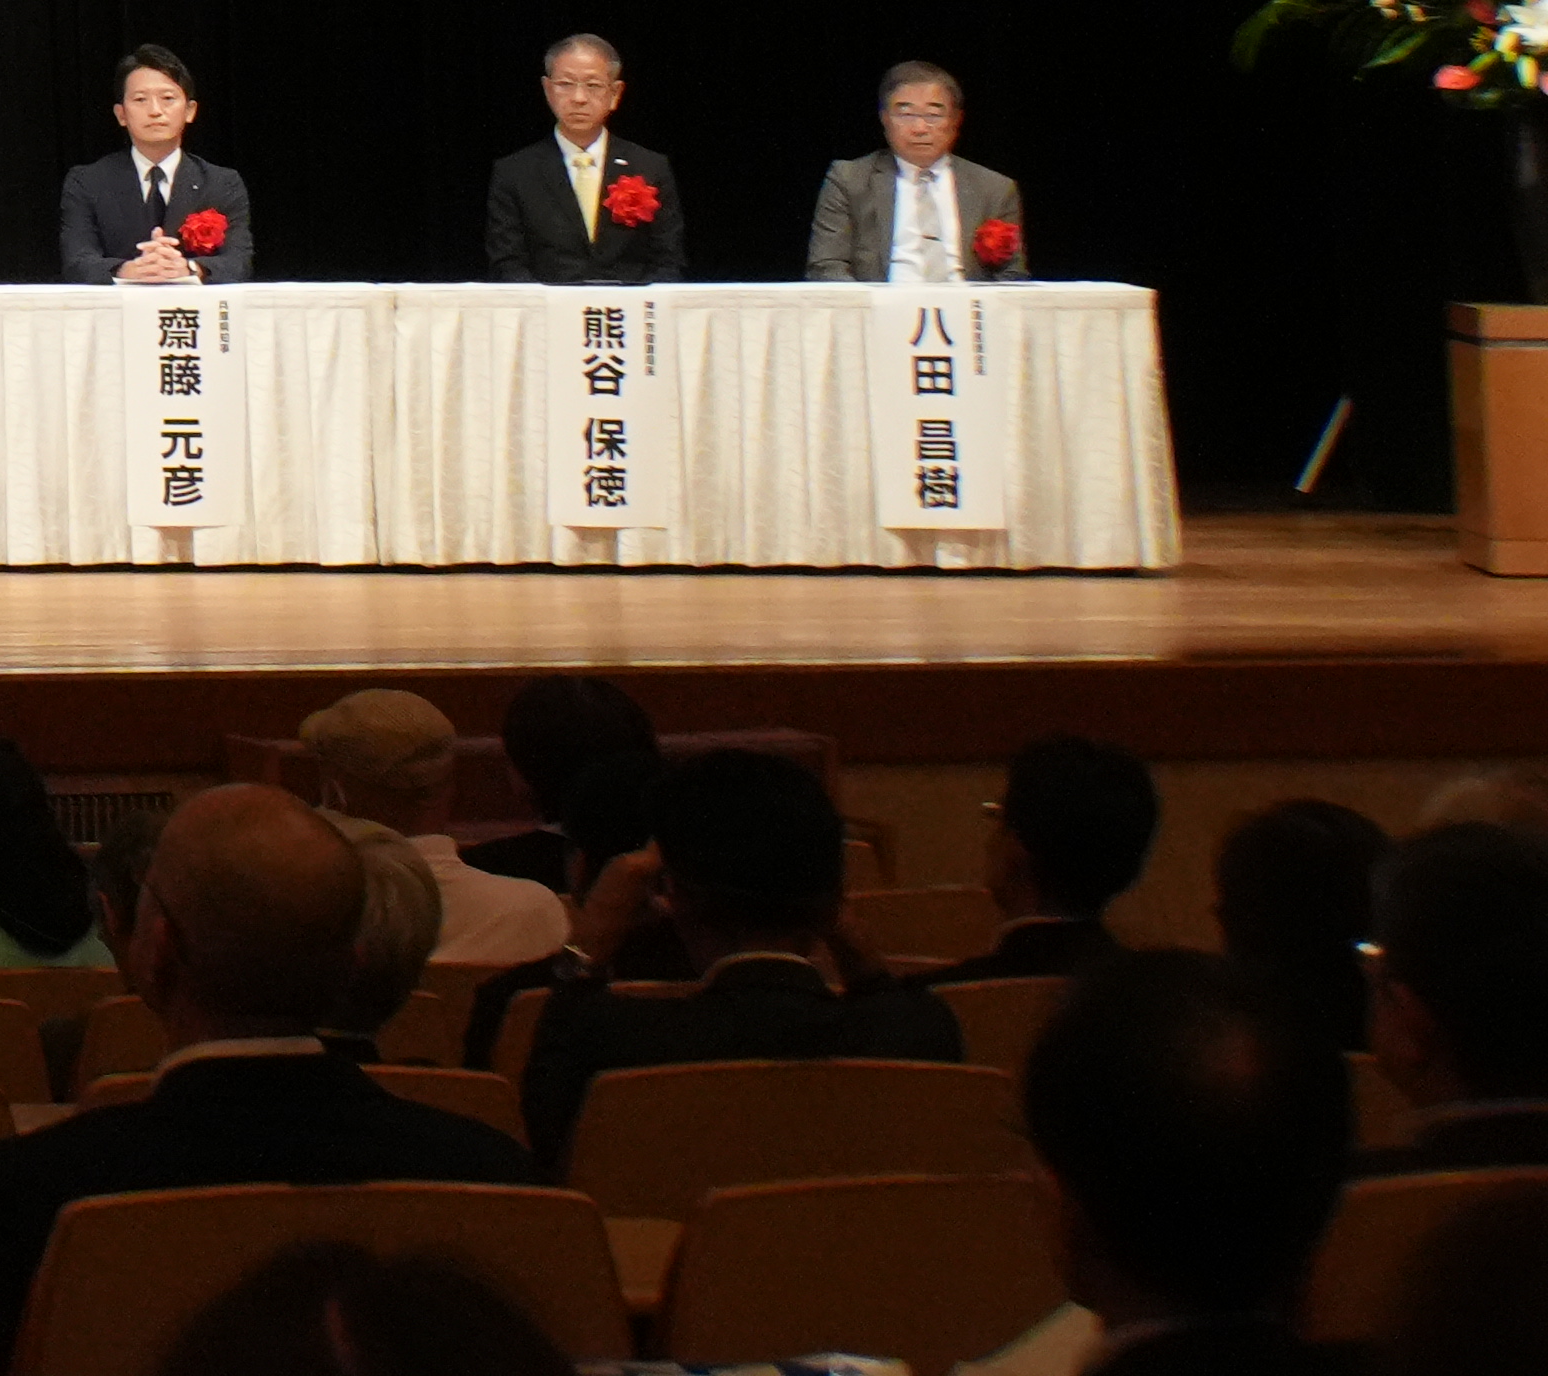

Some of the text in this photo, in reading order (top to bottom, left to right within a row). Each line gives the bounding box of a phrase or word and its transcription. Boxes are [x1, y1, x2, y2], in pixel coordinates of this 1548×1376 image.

[160, 418, 204, 507] 元彦
[582, 306, 628, 508] 熊谷 保徳
[910, 307, 960, 509] 八田 昌樹
